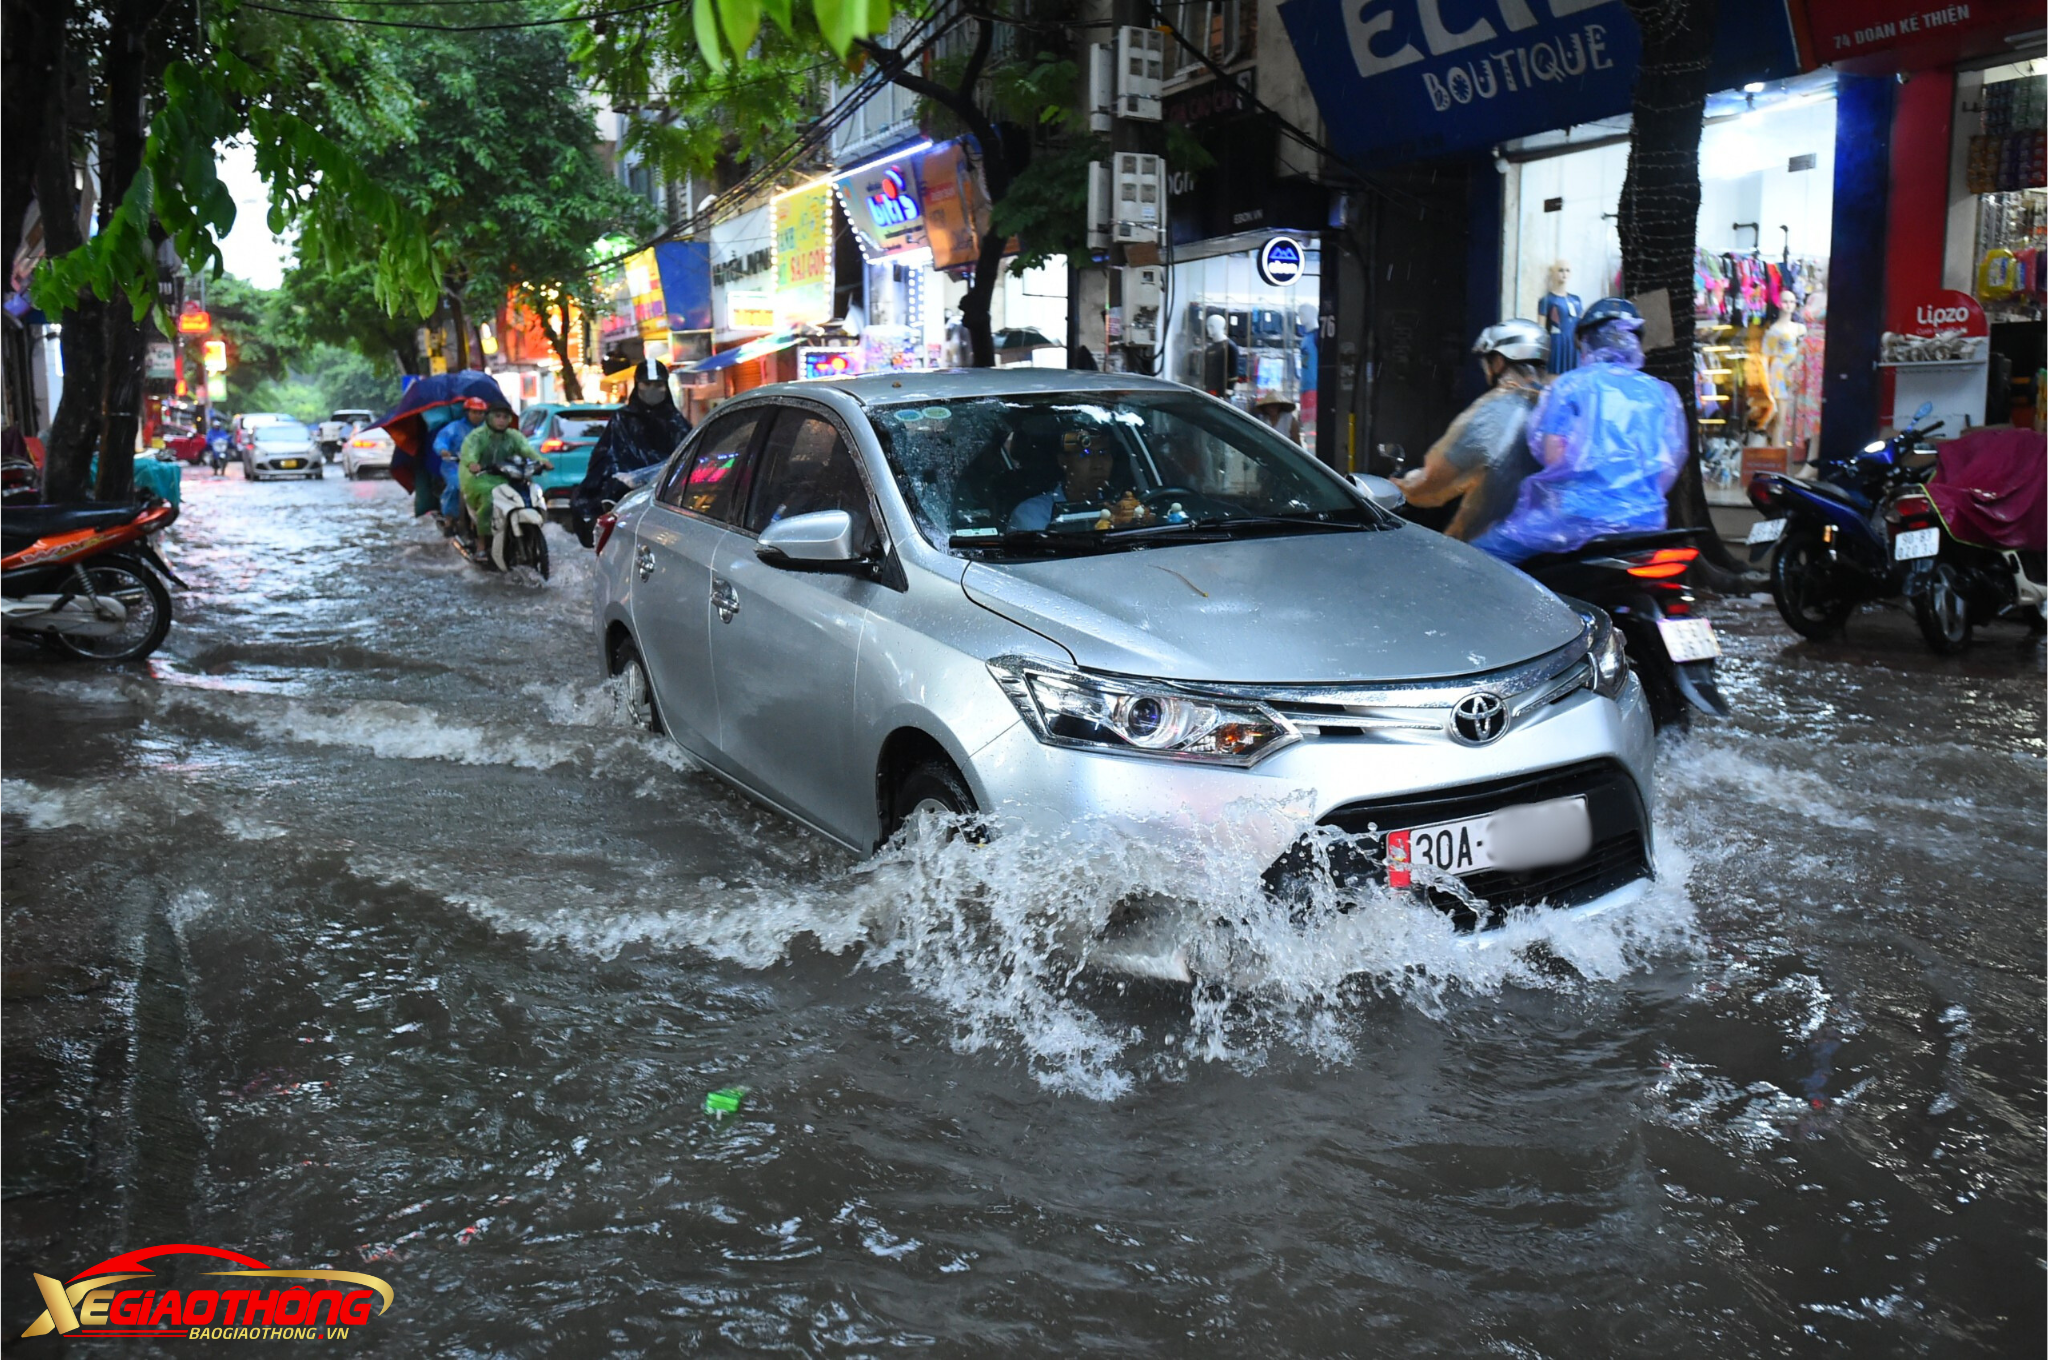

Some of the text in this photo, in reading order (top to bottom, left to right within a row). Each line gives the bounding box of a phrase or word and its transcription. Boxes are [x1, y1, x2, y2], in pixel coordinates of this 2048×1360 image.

[1833, 34, 1851, 49] 74
[1898, 12, 1920, 34] KẾ
[1922, 4, 1970, 28] THIỆN
[1421, 24, 1614, 112] BOUTIQUE
[1319, 315, 1336, 339] 76
[1916, 304, 1969, 327] Lipzo
